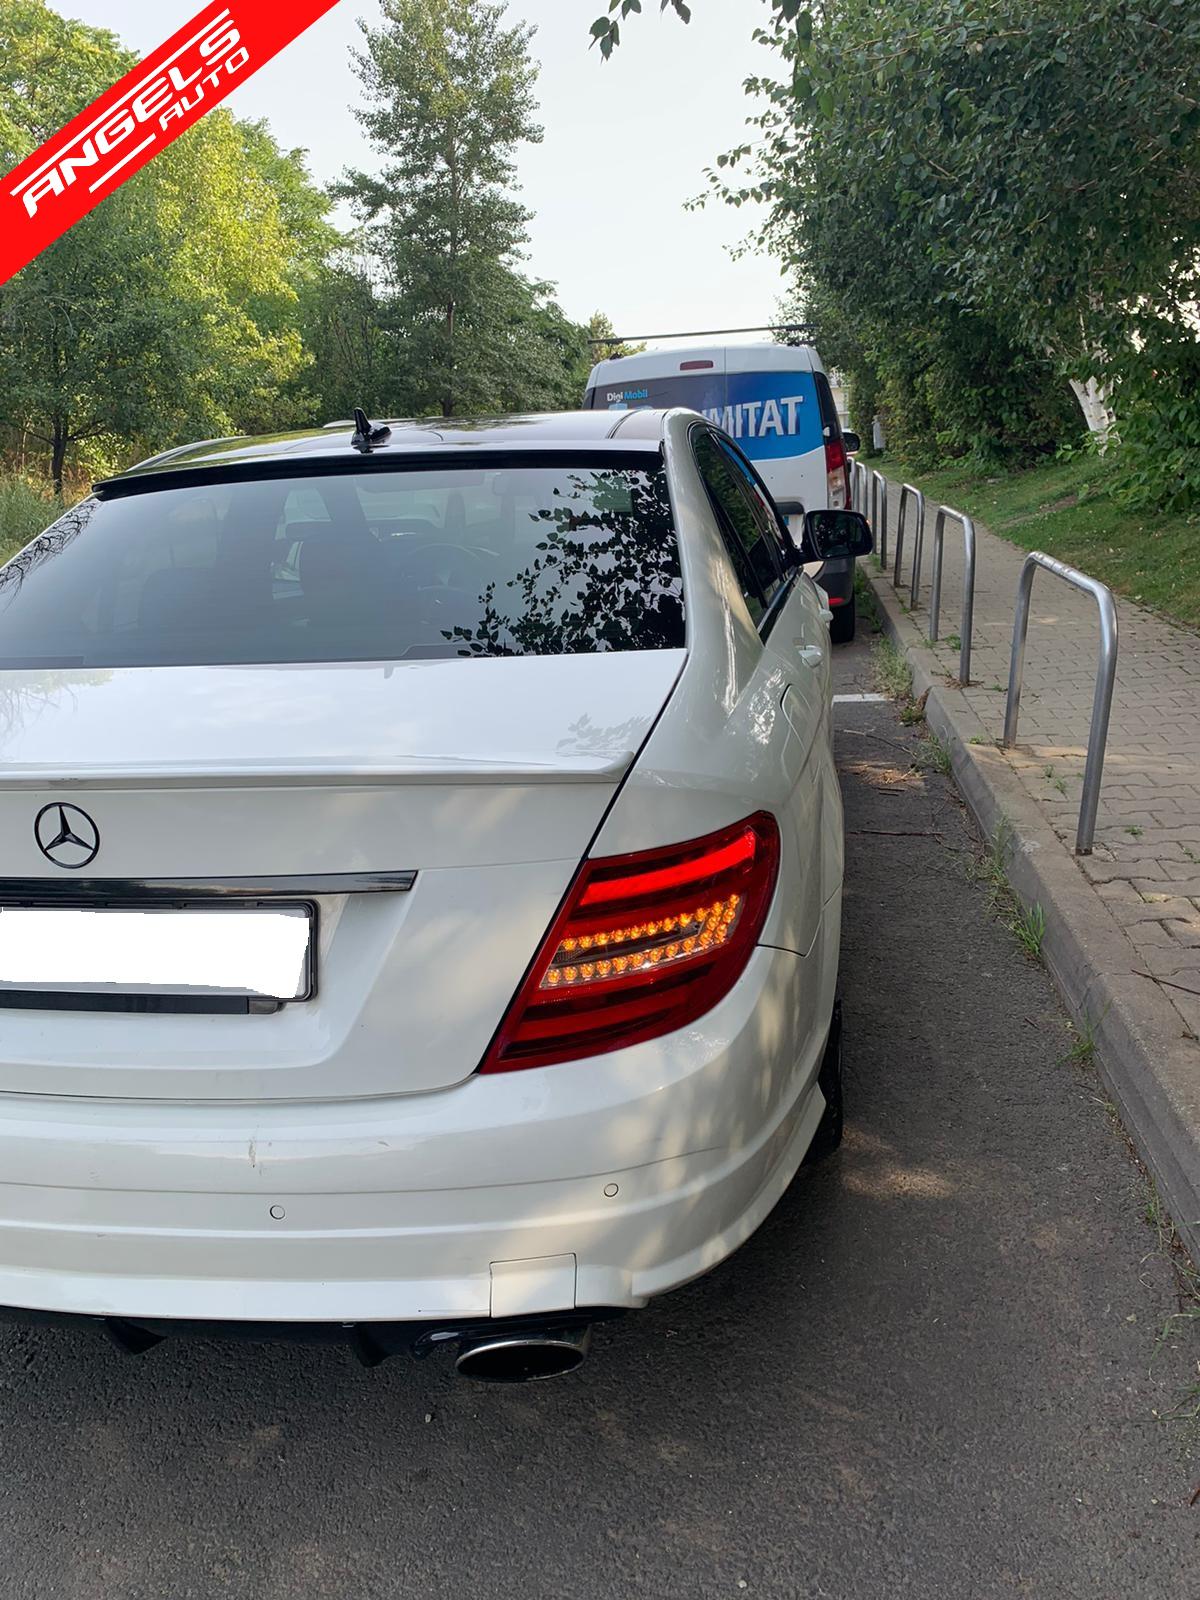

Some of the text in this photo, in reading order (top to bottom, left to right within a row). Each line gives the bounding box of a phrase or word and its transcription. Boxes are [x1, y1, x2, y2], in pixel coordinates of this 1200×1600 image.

[606, 389, 648, 403] Digi Mobil
[701, 395, 803, 438] MITAT
